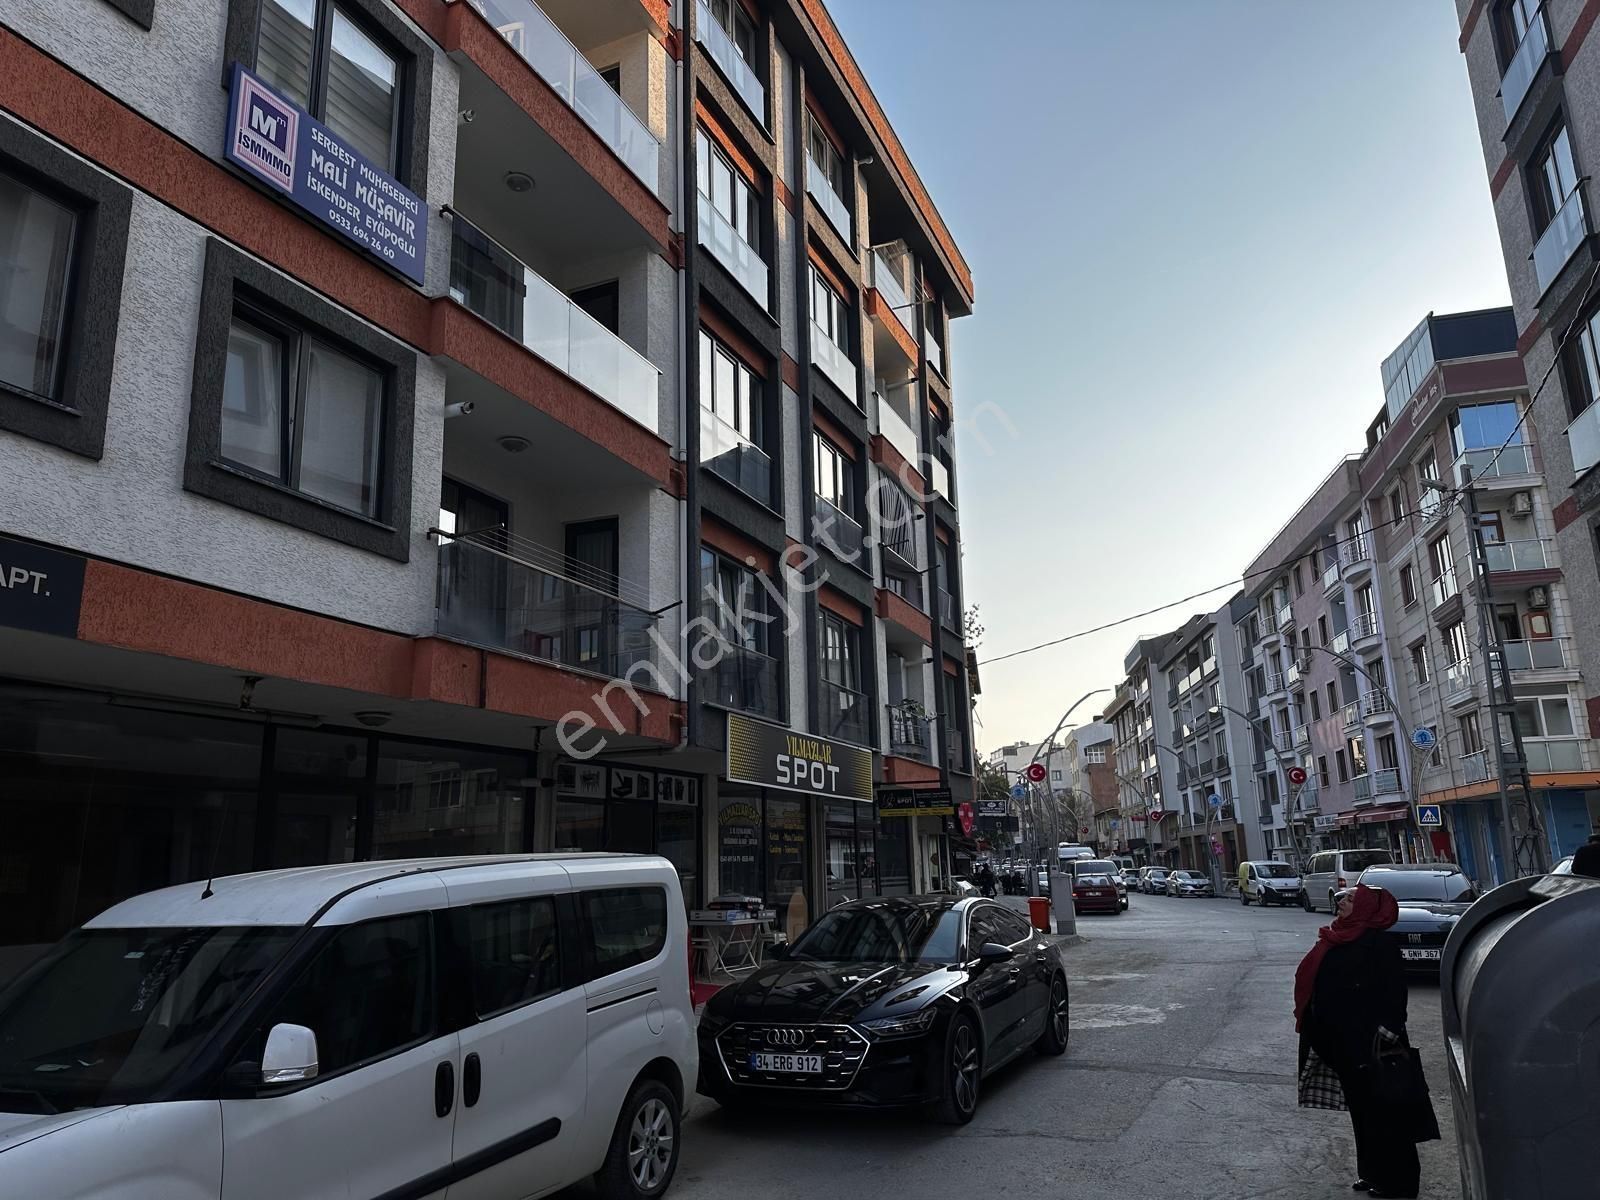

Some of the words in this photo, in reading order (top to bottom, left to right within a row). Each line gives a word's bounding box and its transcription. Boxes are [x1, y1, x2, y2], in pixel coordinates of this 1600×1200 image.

[238, 128, 291, 177] İSMMMO
[311, 127, 357, 169] SERBEST
[360, 163, 418, 215] MUHASEBECİ
[306, 172, 361, 222] İSKENDER
[311, 148, 348, 190] MALİ
[355, 181, 415, 240] MÜŞAVİR
[329, 209, 351, 231] 0533
[352, 226, 369, 244] 694
[371, 238, 382, 251] 26
[383, 247, 395, 259] 60
[786, 735, 832, 764] YILMAZLAR
[776, 754, 840, 792] SPOT
[1407, 933, 1422, 943] FIAT
[1424, 950, 1438, 958] 367
[756, 1055, 769, 1069] 34
[773, 1055, 793, 1071] ERG
[797, 1056, 818, 1071] 912
